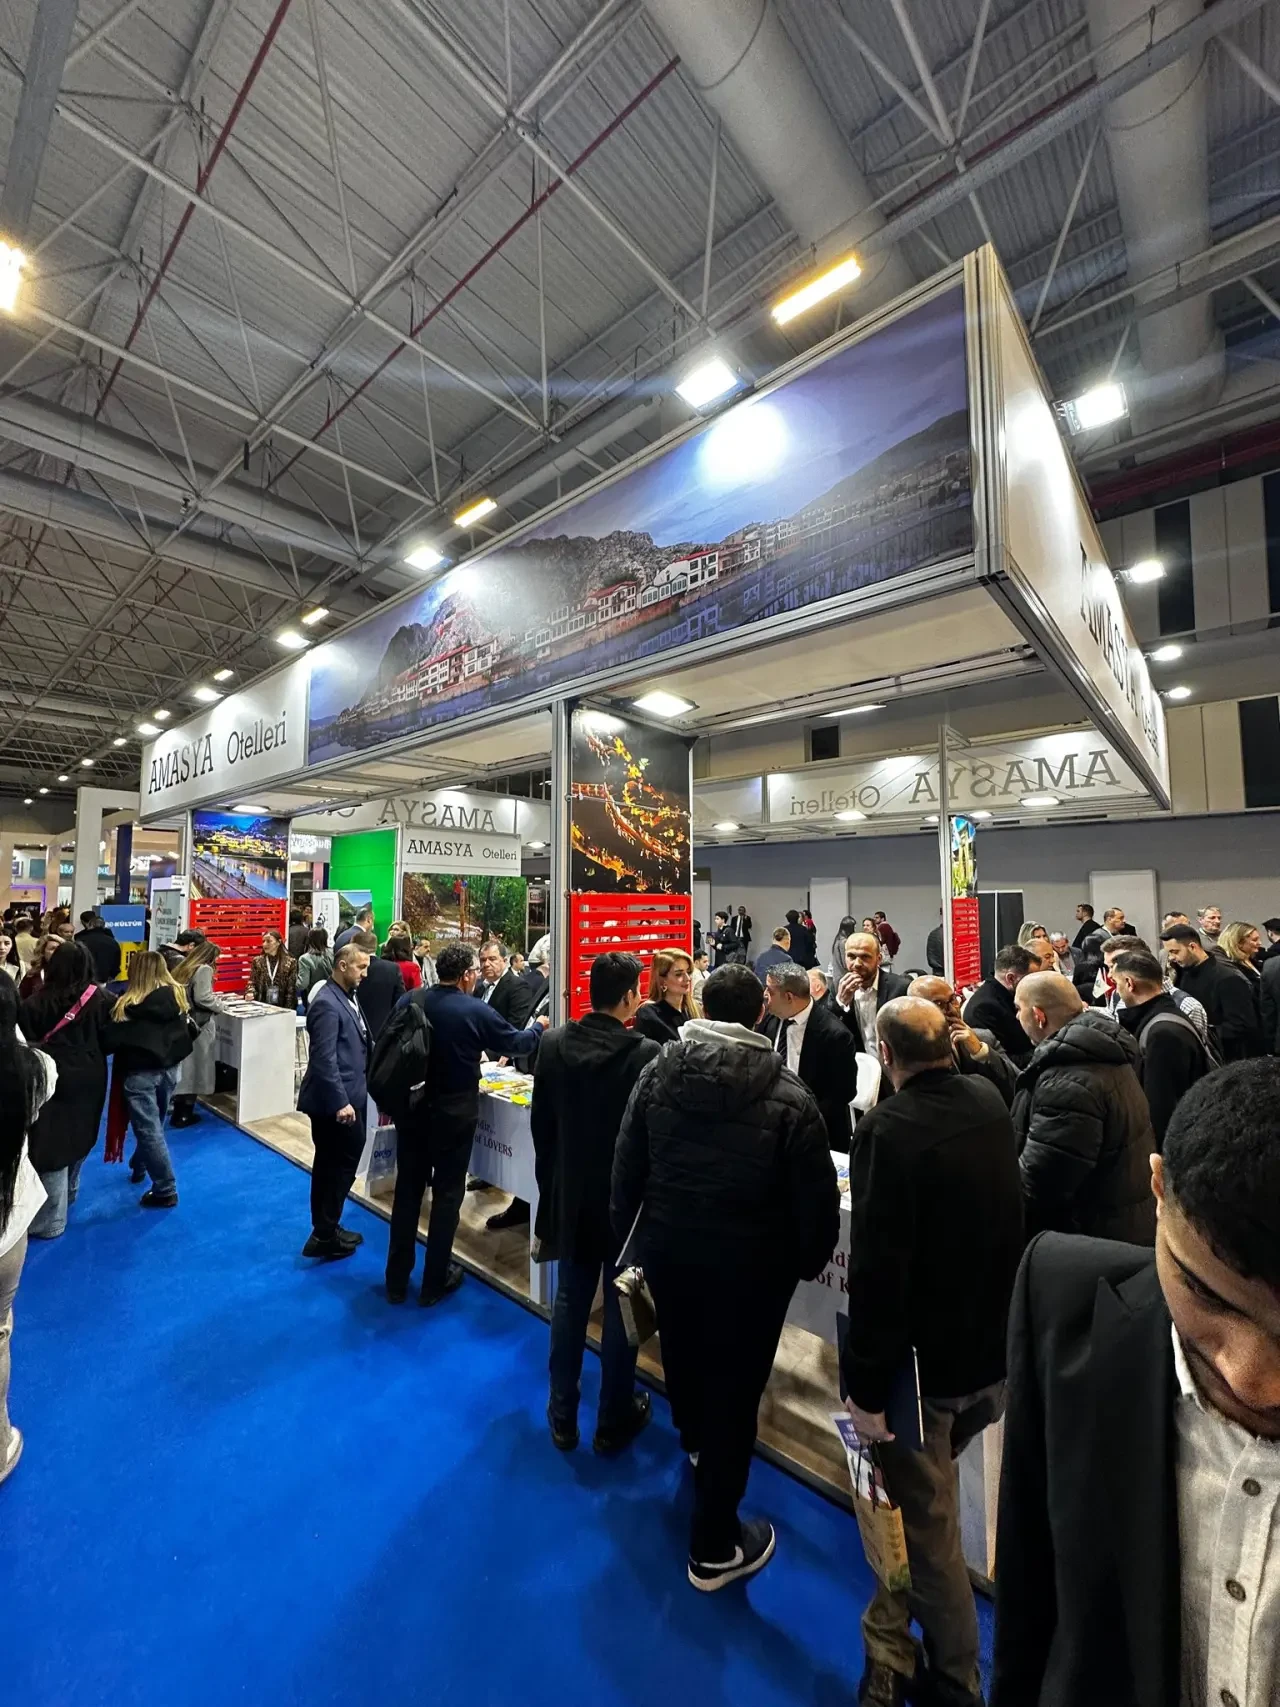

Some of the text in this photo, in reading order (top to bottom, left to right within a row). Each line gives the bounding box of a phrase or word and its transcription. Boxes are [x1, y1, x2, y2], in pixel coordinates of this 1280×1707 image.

[148, 710, 287, 795] AMASYA Otelleri
[406, 839, 518, 861] AMASYA Otelleri
[484, 1136, 512, 1157] LOVERS
